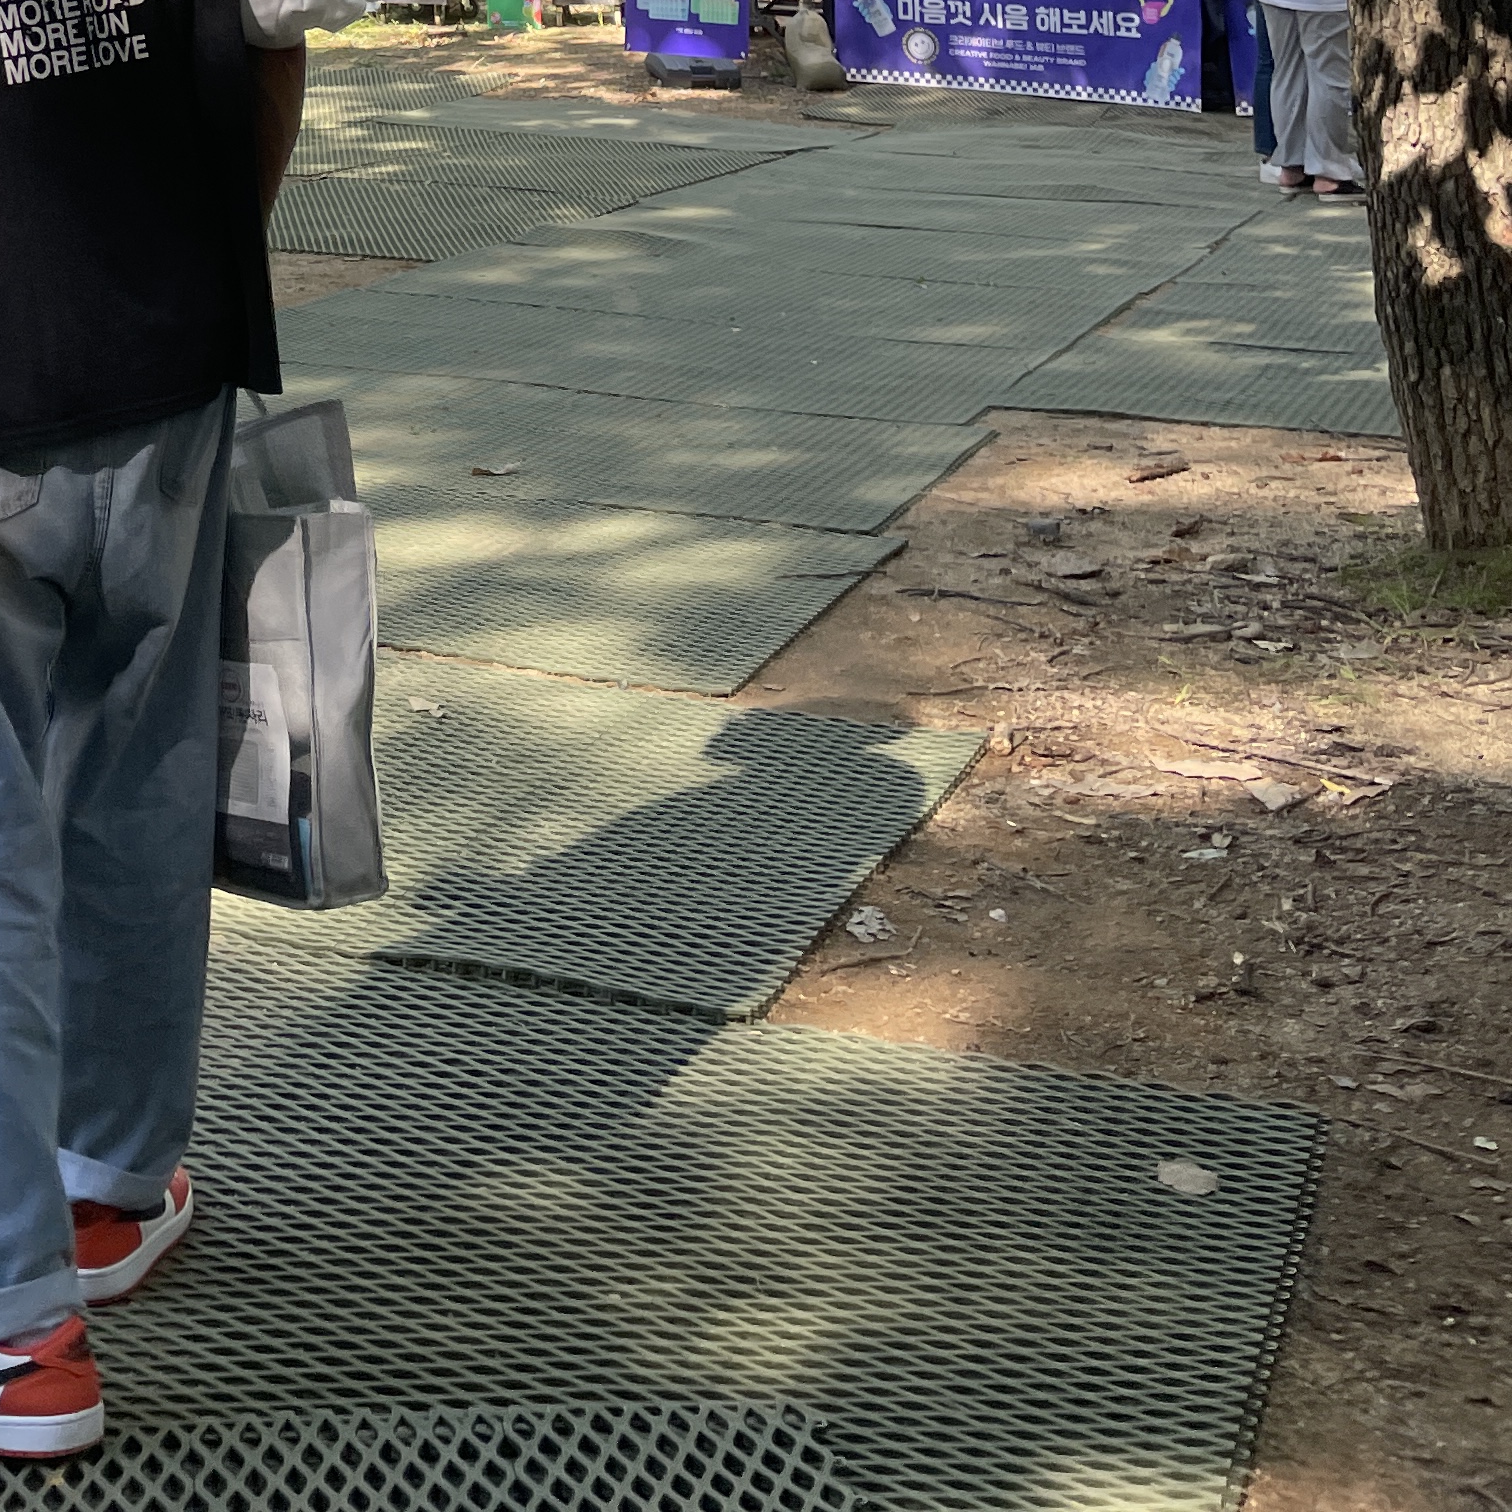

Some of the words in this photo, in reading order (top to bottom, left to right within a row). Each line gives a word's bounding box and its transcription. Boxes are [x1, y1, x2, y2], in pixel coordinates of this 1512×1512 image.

[85, 10, 130, 41] FUN
[978, 2, 1029, 31] 시음
[1035, 5, 1142, 39] 해보세요
[3, 45, 90, 86] MORE
[89, 34, 150, 69] LOVE
